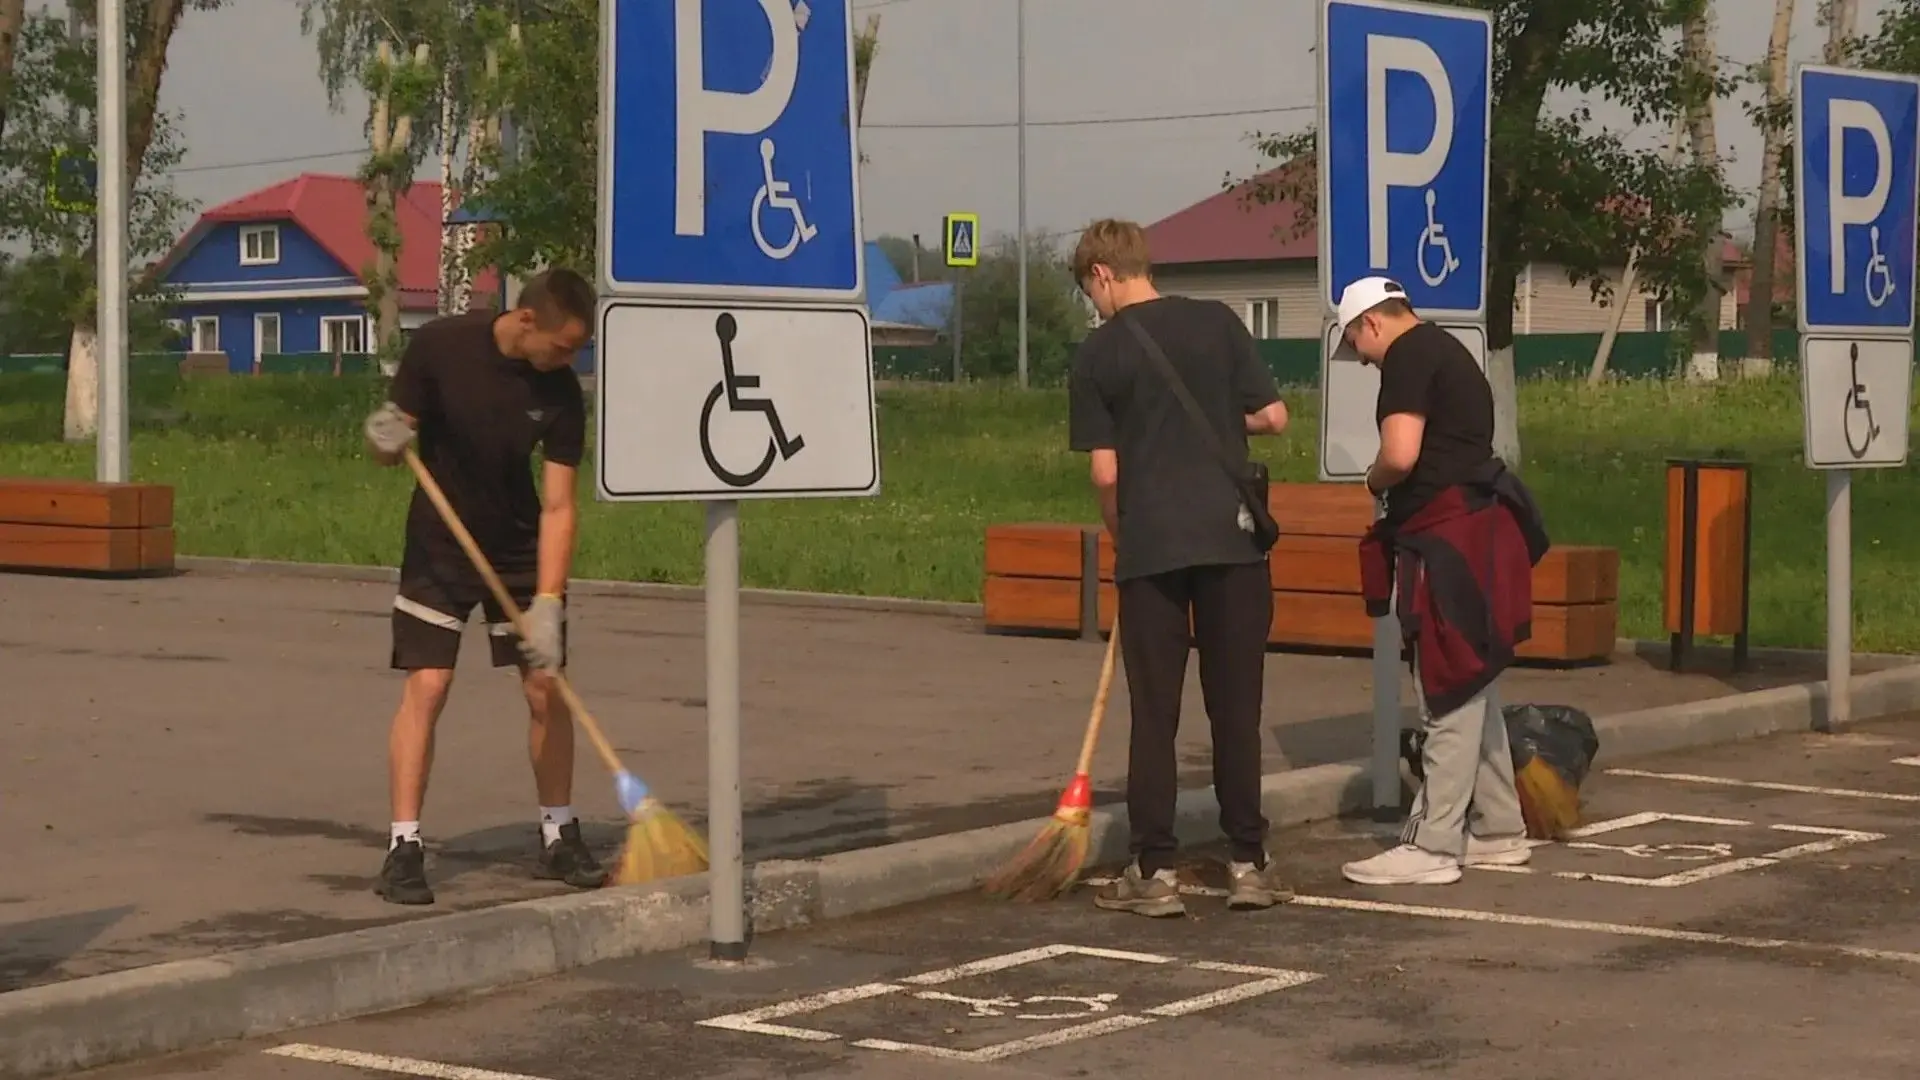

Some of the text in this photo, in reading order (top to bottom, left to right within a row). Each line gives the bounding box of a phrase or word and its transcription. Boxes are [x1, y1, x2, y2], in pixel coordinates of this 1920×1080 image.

[675, 0, 800, 236] P
[1366, 34, 1455, 269] P
[1828, 98, 1893, 294] P
